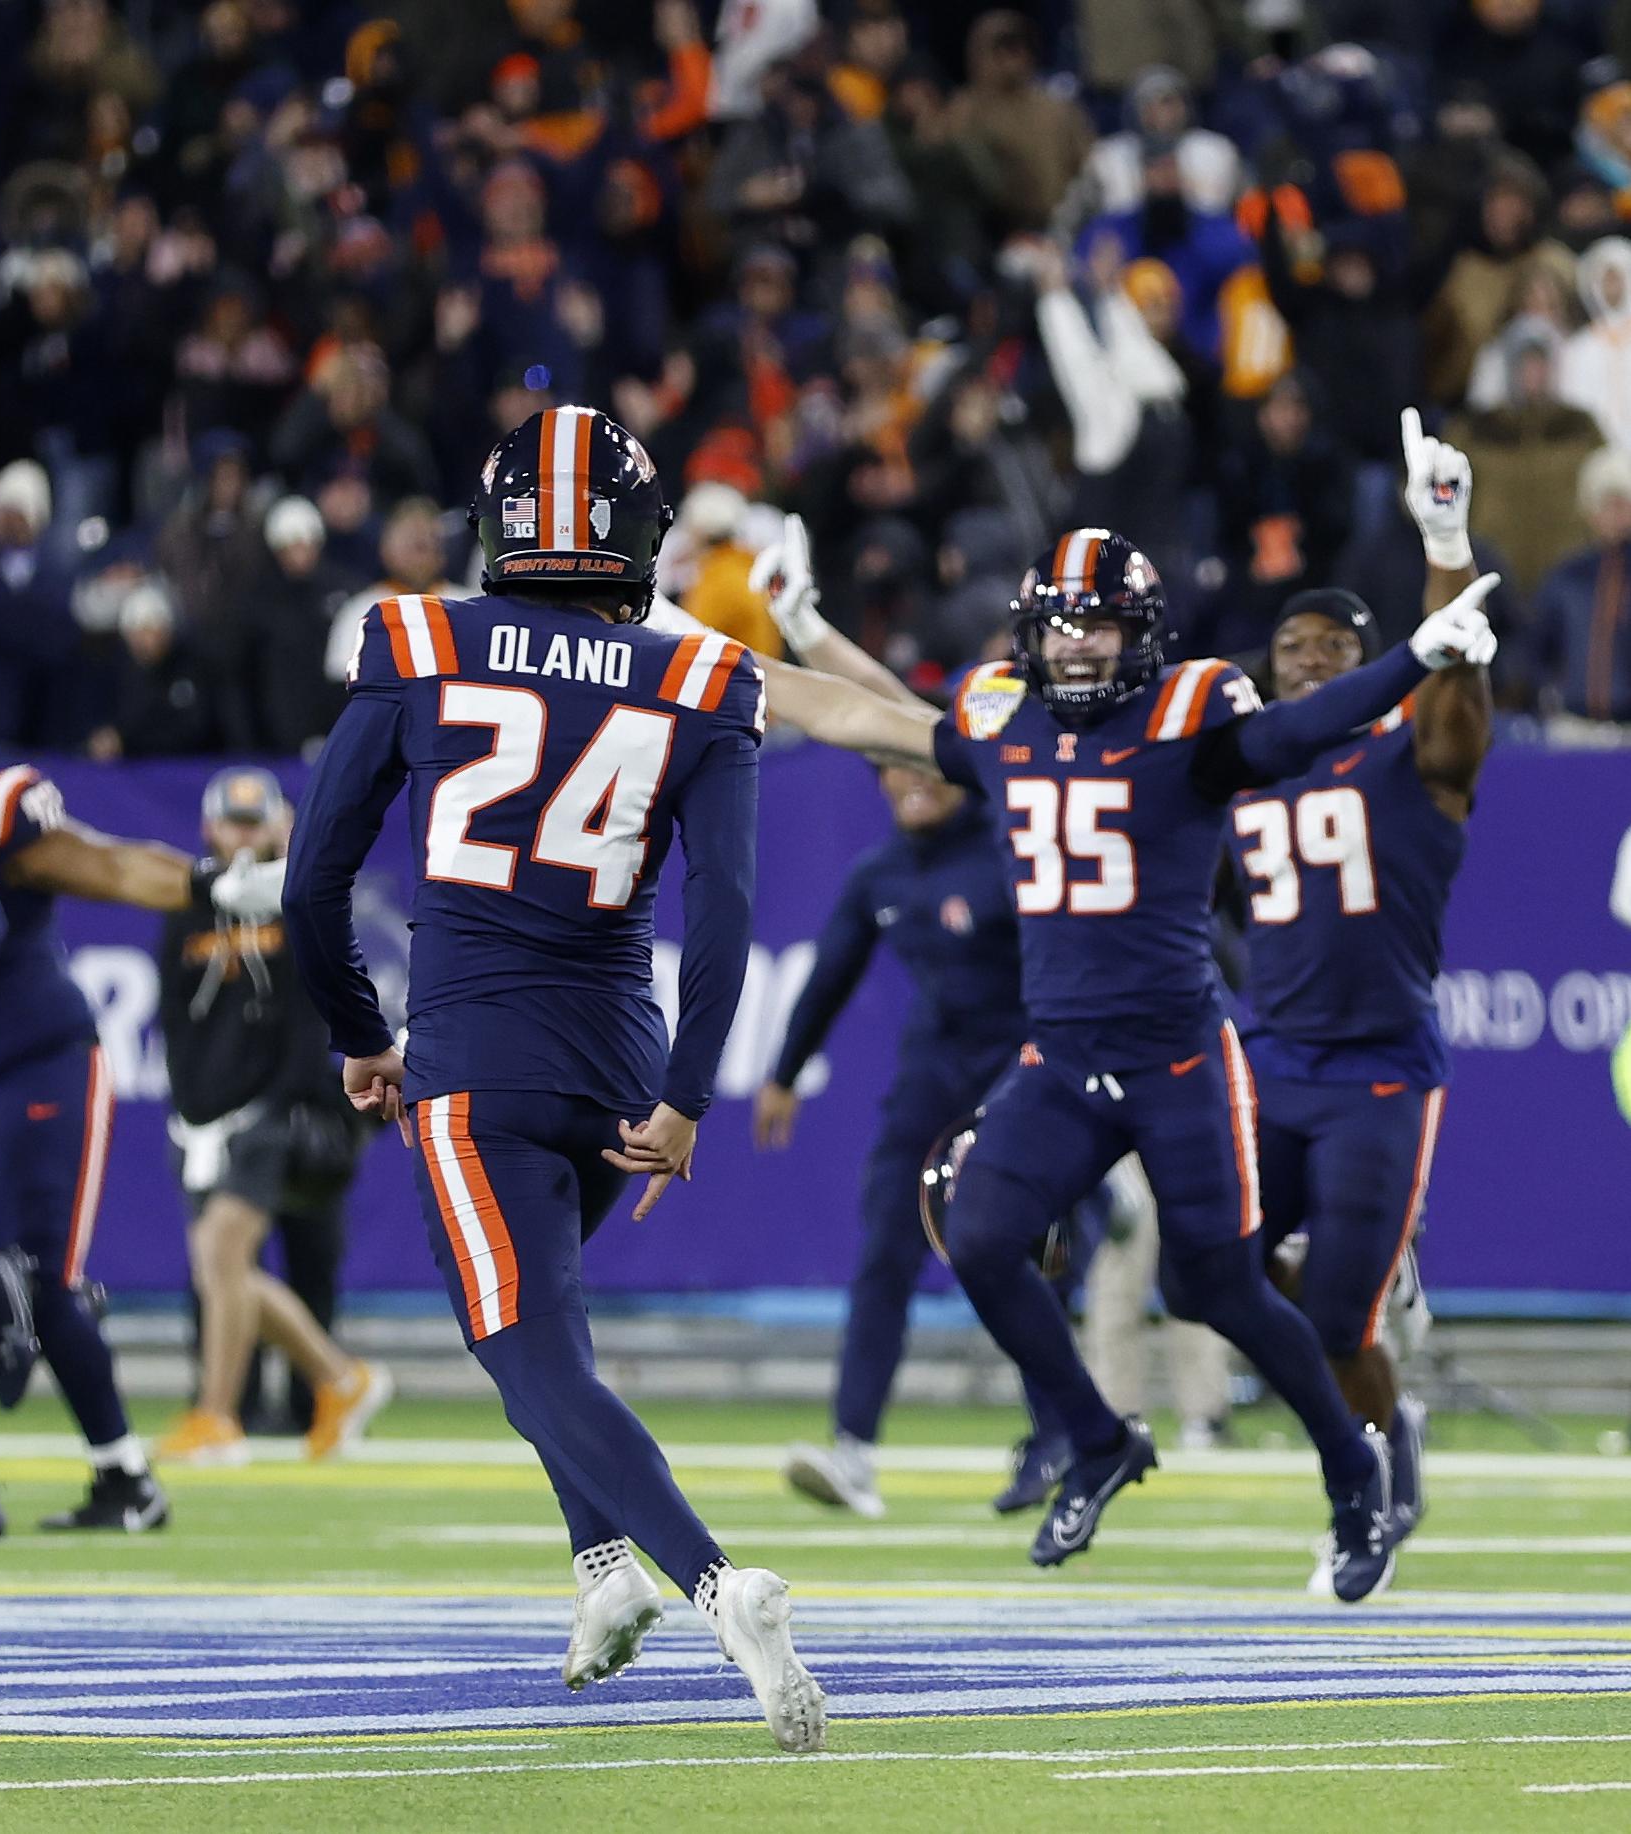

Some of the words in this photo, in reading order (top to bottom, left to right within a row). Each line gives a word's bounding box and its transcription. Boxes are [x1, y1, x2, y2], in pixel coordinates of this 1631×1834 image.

[502, 558, 577, 576] FIGHTING
[487, 623, 633, 689] OLANO
[424, 680, 678, 911] 24
[1004, 775, 1139, 916] 35
[1232, 785, 1380, 926] 39
